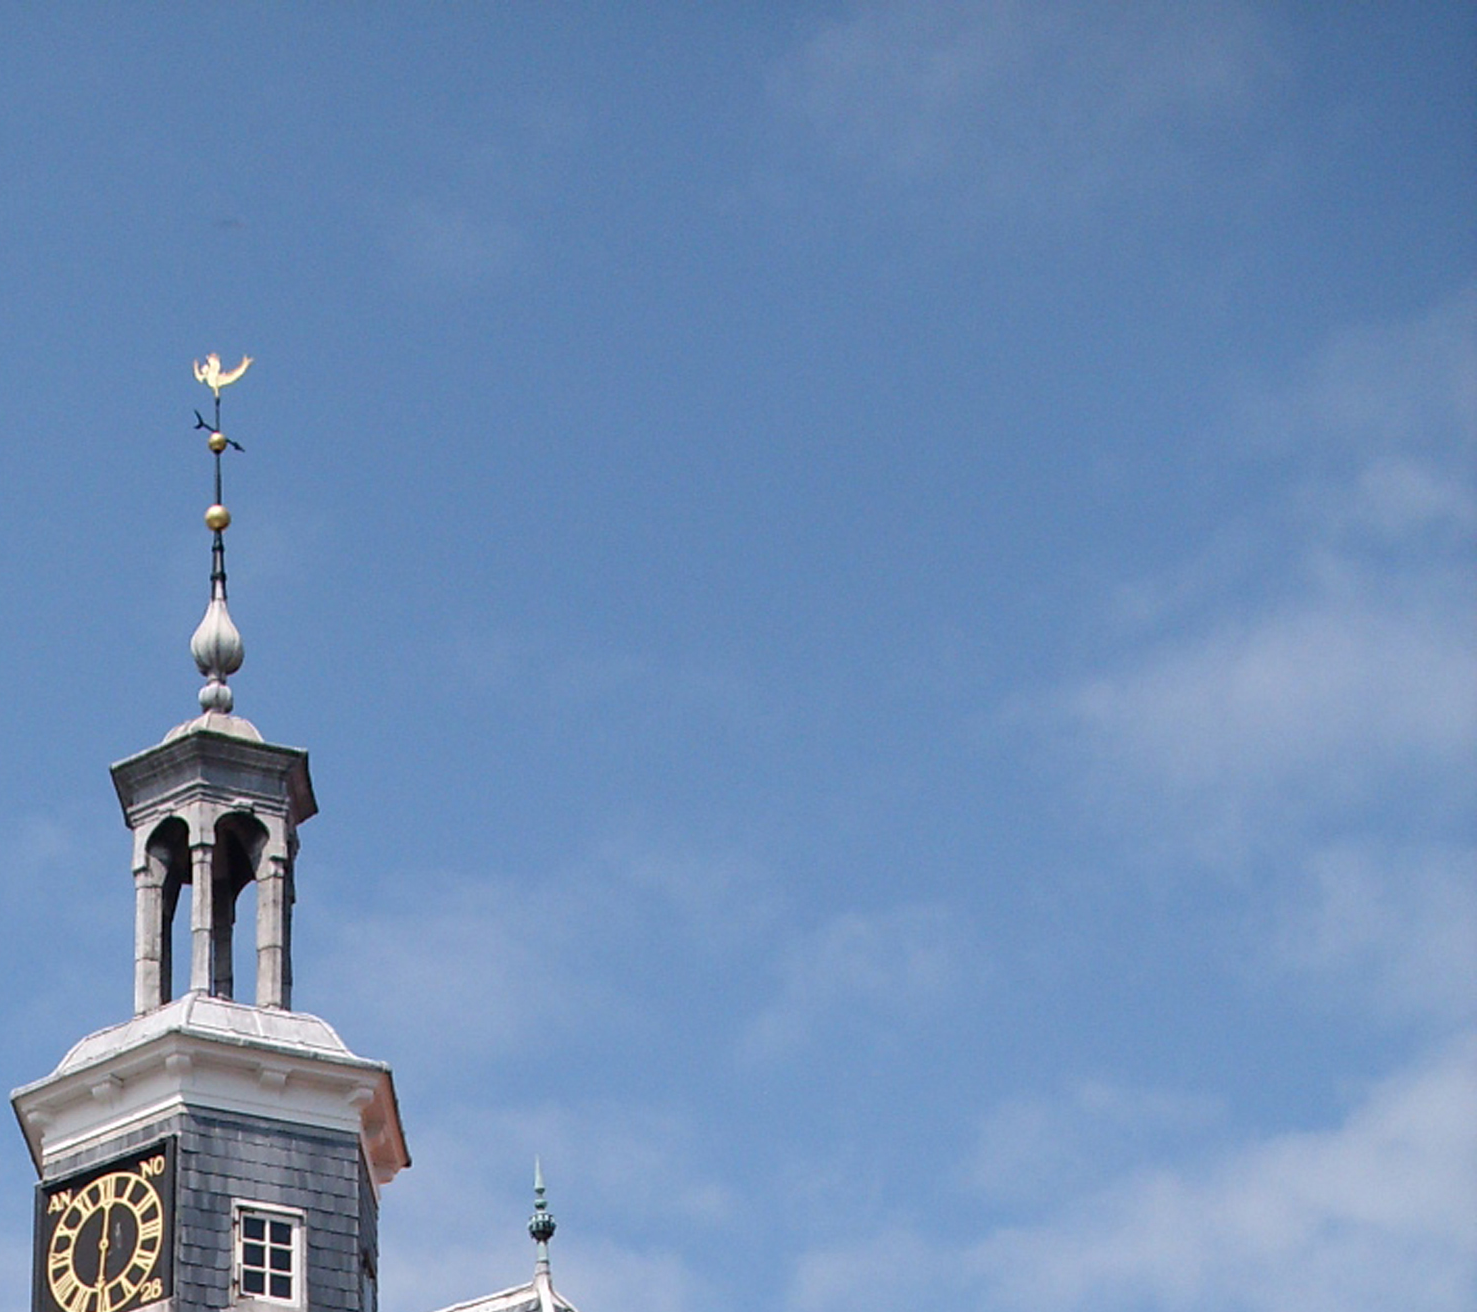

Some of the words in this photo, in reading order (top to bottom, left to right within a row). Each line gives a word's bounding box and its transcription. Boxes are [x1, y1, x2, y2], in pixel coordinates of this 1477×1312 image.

[47, 1189, 72, 1215] AN
[138, 1155, 165, 1180] NO
[139, 1278, 163, 1304] 28
